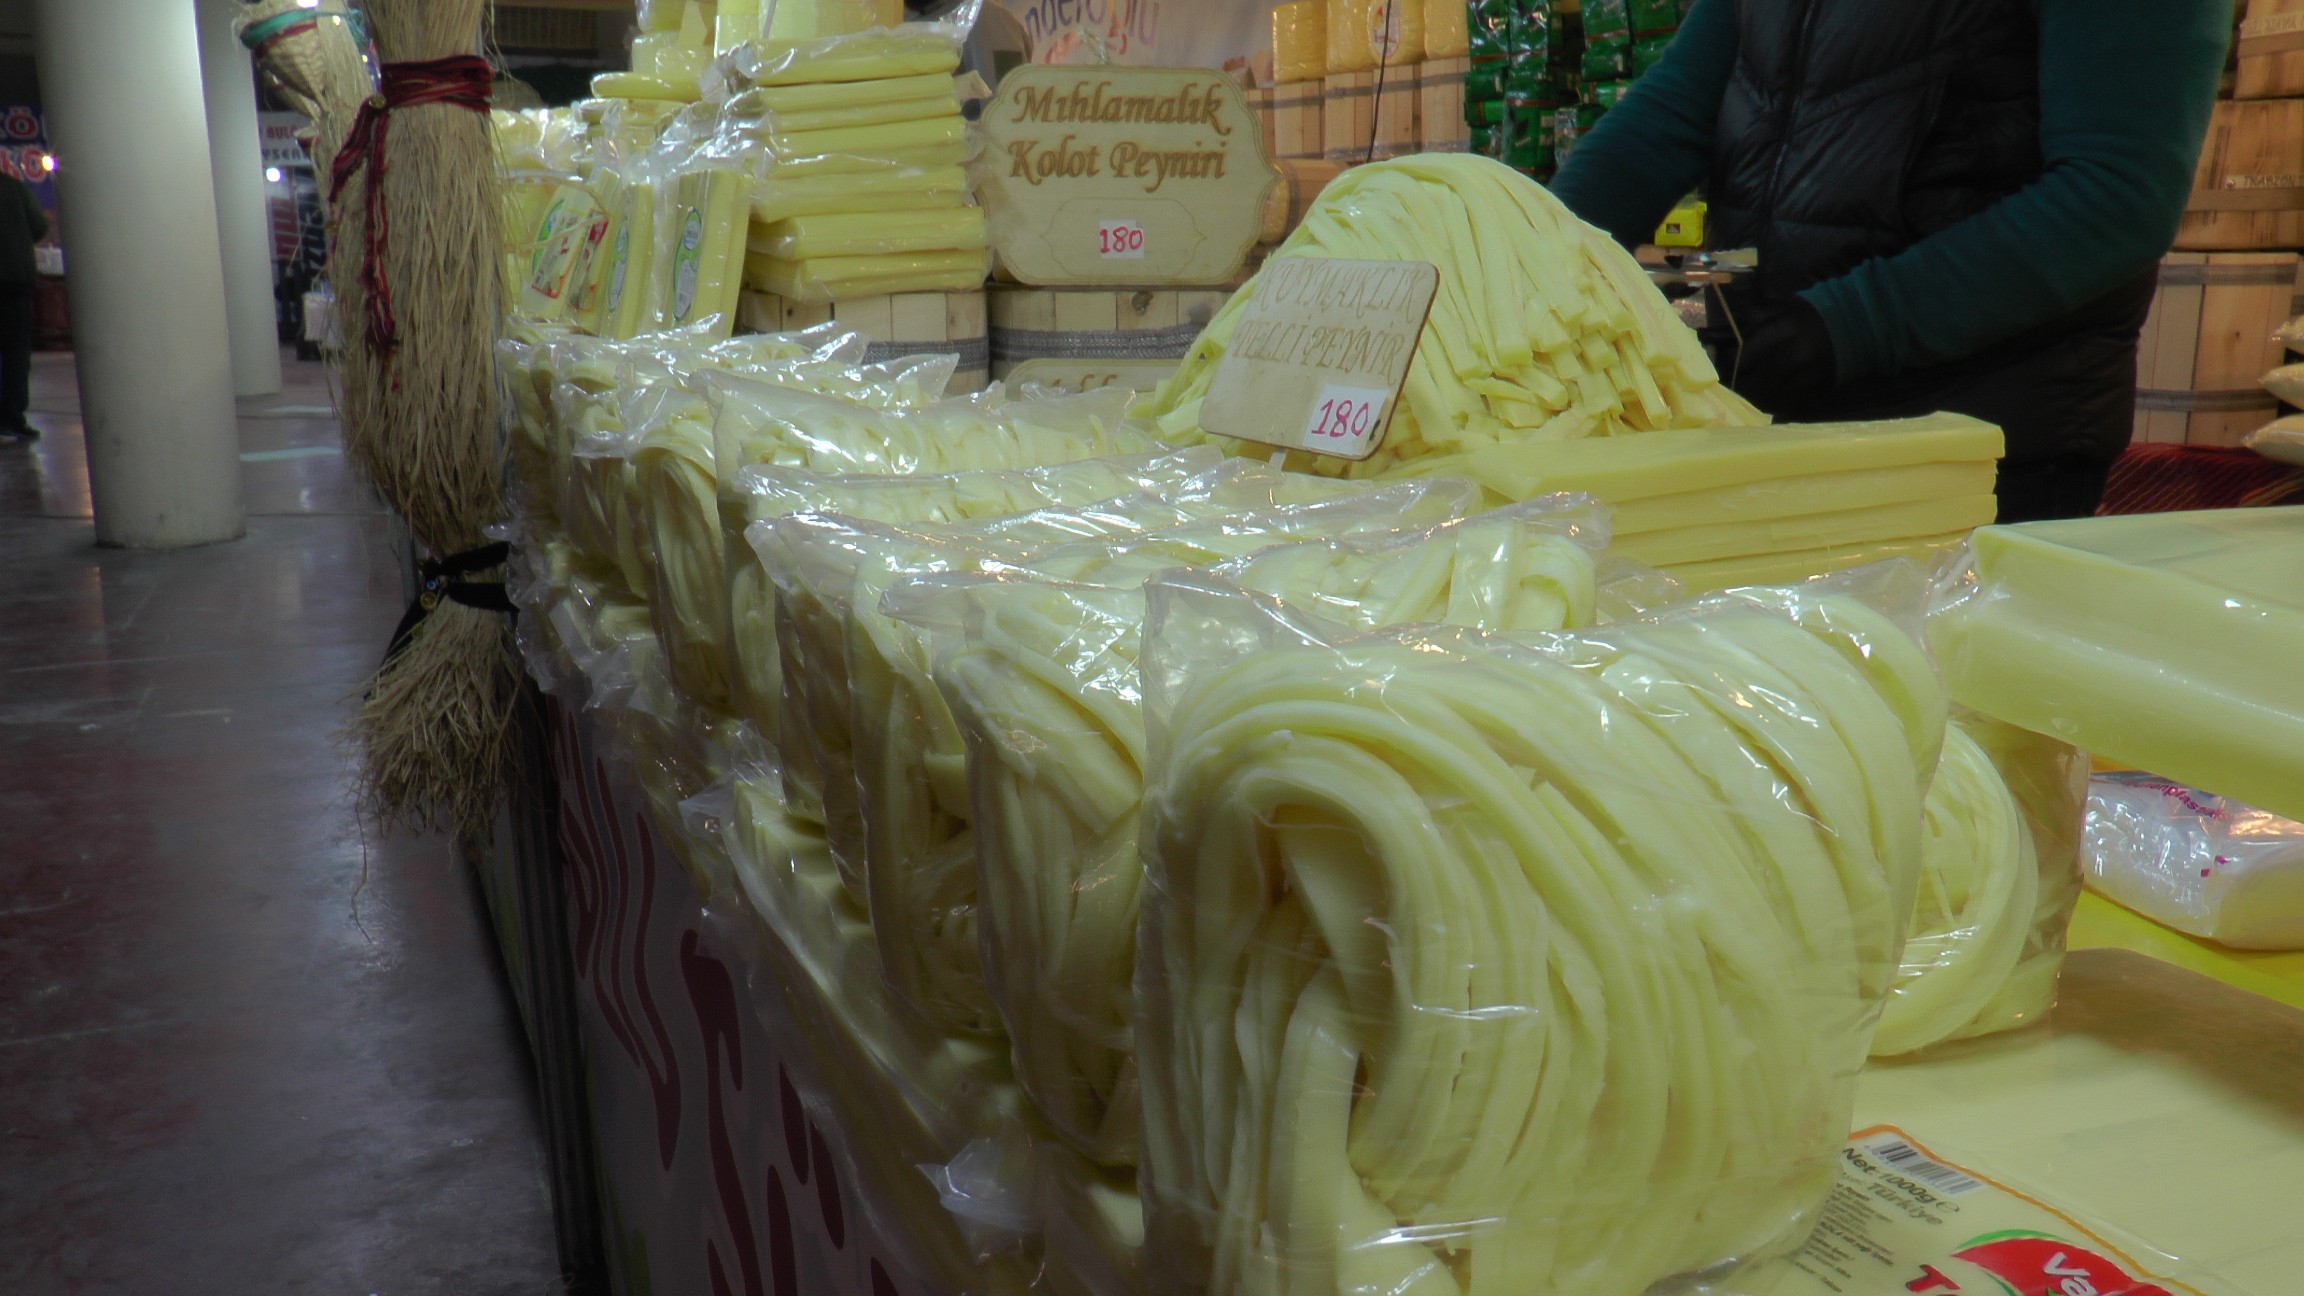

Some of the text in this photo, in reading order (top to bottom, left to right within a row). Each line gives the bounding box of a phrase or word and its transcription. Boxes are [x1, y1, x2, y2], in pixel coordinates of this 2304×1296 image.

[1007, 135, 1228, 193] Kolot Peyniri
[1100, 226, 1143, 254] 180
[1310, 399, 1370, 438] 180
[1867, 1181, 1943, 1225] Türkiye
